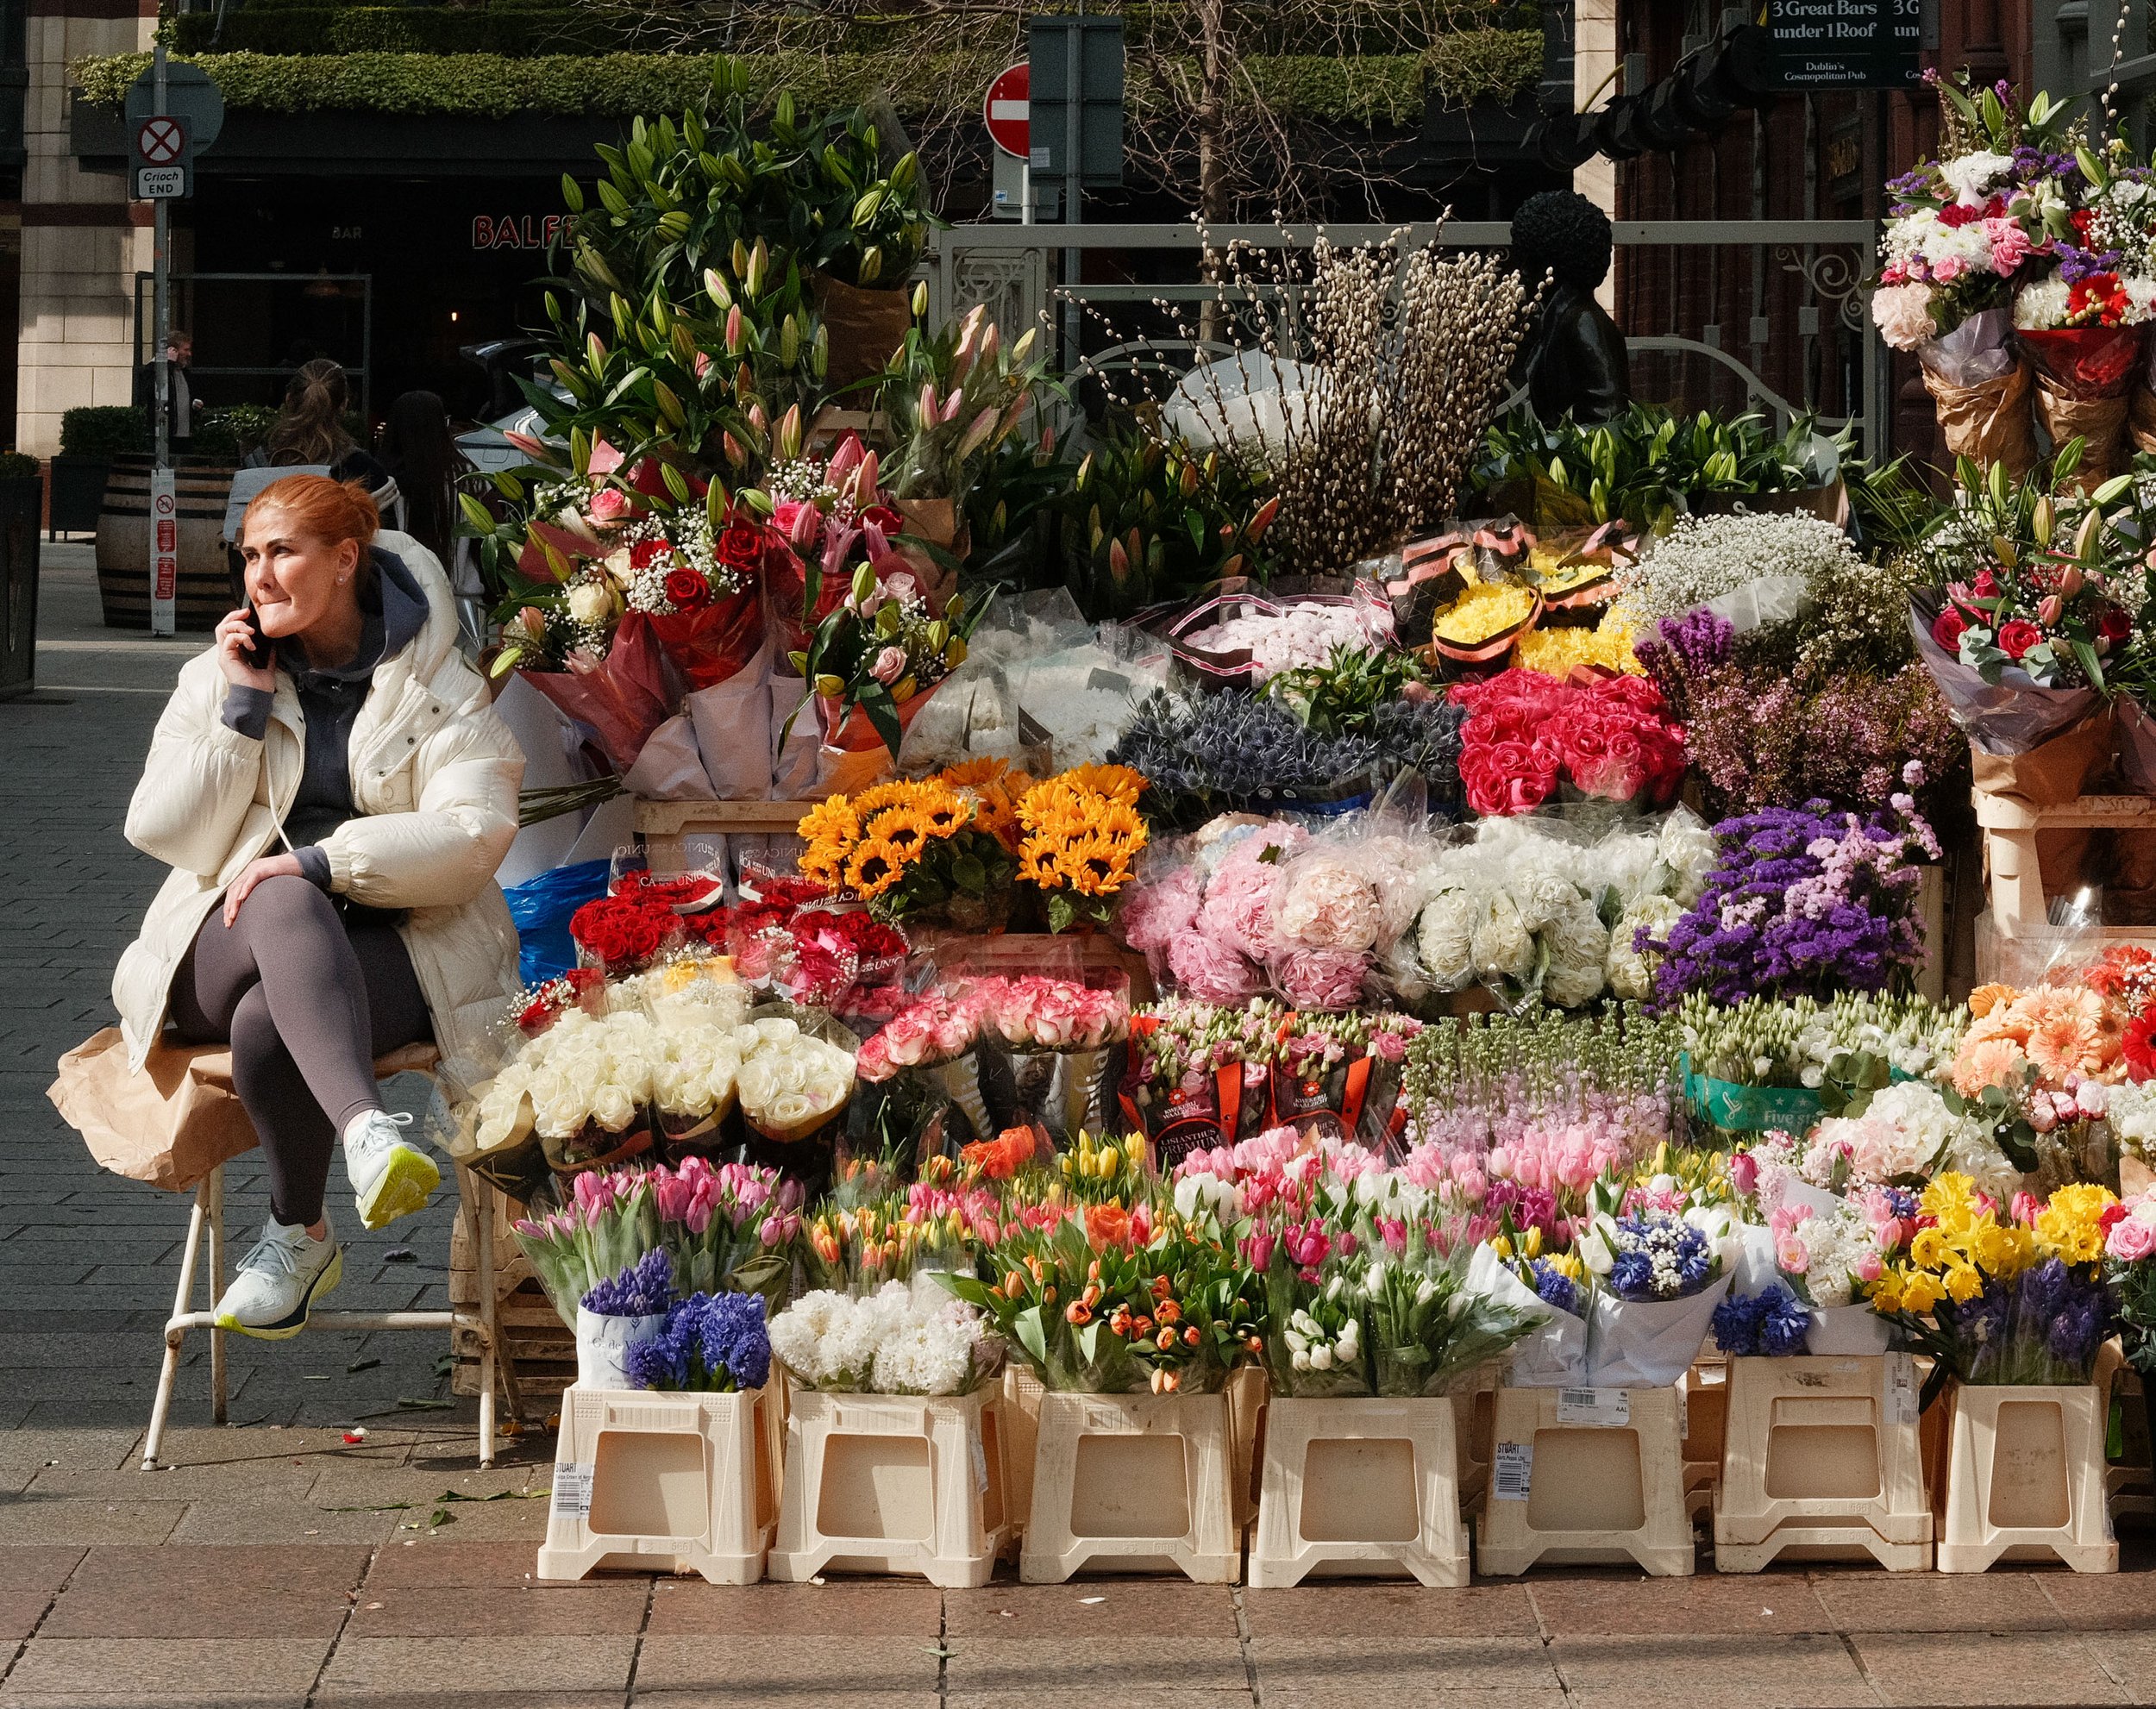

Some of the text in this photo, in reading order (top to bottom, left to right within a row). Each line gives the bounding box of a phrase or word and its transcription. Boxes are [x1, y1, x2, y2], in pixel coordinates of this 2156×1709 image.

[1772, 0, 1878, 17] 3 Great Bars
[1893, 0, 1904, 16] 3
[1773, 22, 1878, 39] under 1 Roof
[1784, 71, 1867, 83] Cosmopolitan Pub
[148, 184, 174, 194] END
[332, 226, 362, 240] BAR
[1764, 1109, 1794, 1124] Five
[1160, 1134, 1222, 1155] PREMIUM
[1161, 1128, 1216, 1146] LISIANTHUS
[1497, 1443, 1520, 1454] STUART
[556, 1462, 577, 1473] STUART
